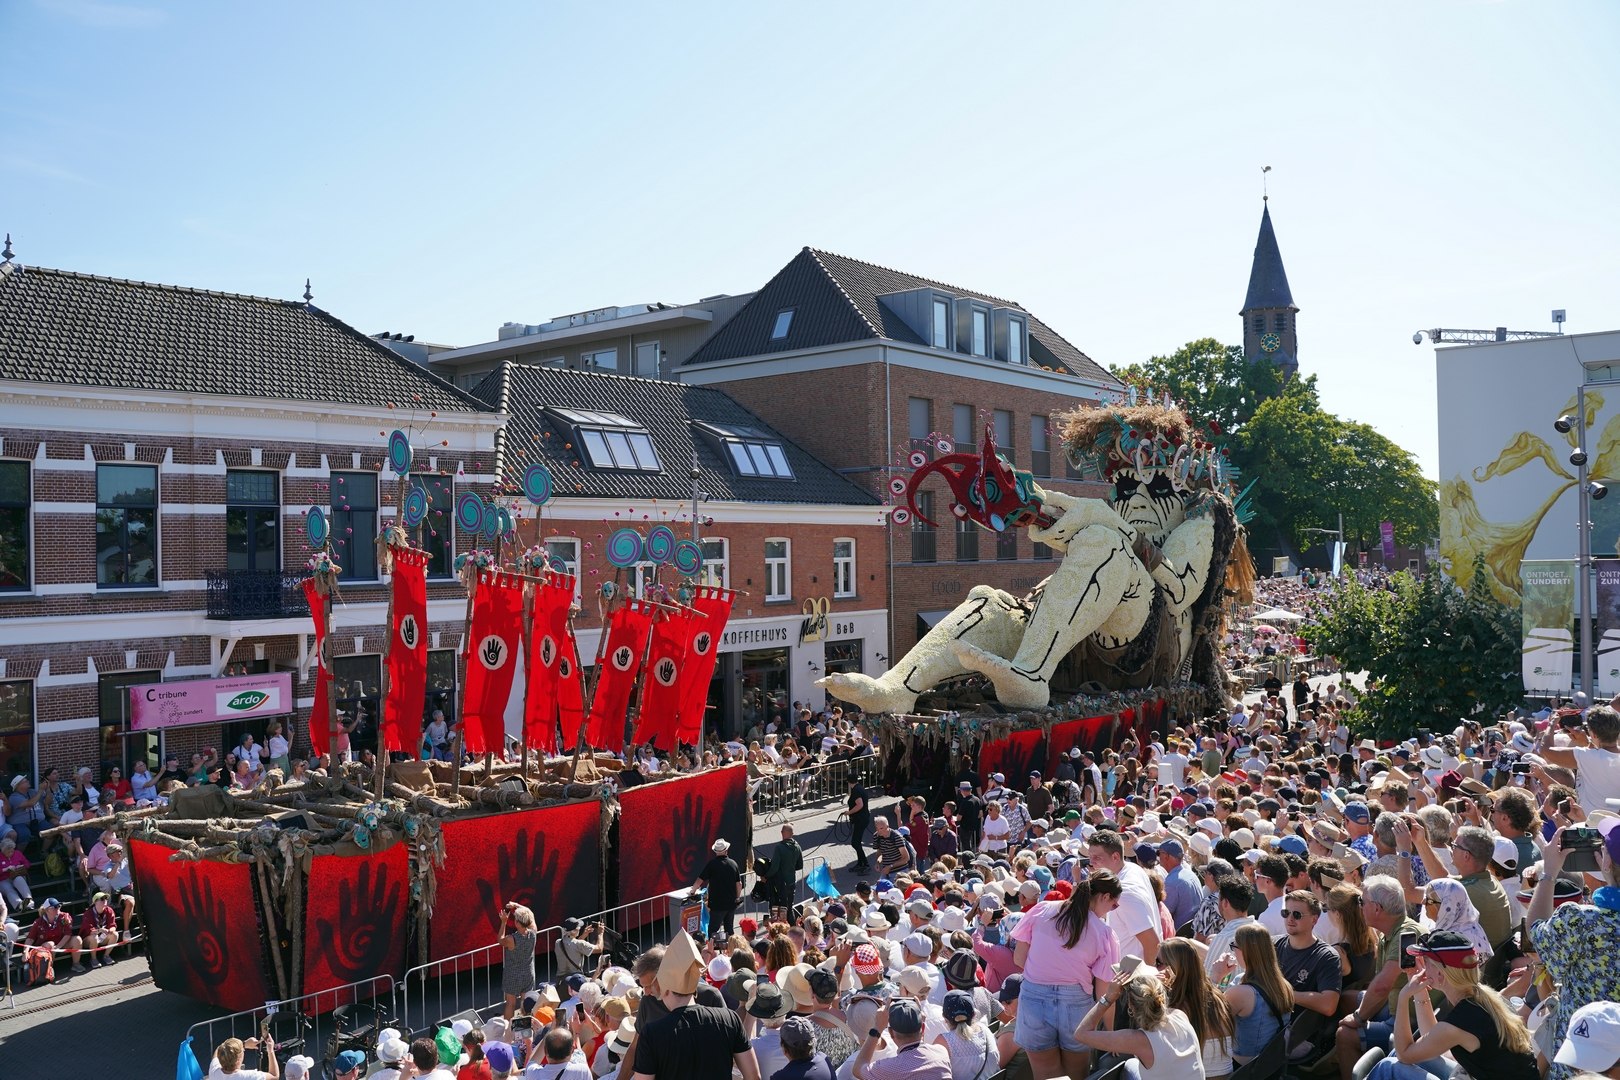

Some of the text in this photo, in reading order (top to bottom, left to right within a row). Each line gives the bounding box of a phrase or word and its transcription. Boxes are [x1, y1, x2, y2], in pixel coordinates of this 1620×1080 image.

[931, 579, 962, 595] FOOD
[723, 627, 787, 645] KOFFIEHUYS
[798, 611, 826, 648] Markt
[146, 688, 188, 702] C tribune
[232, 694, 260, 706] ardo
